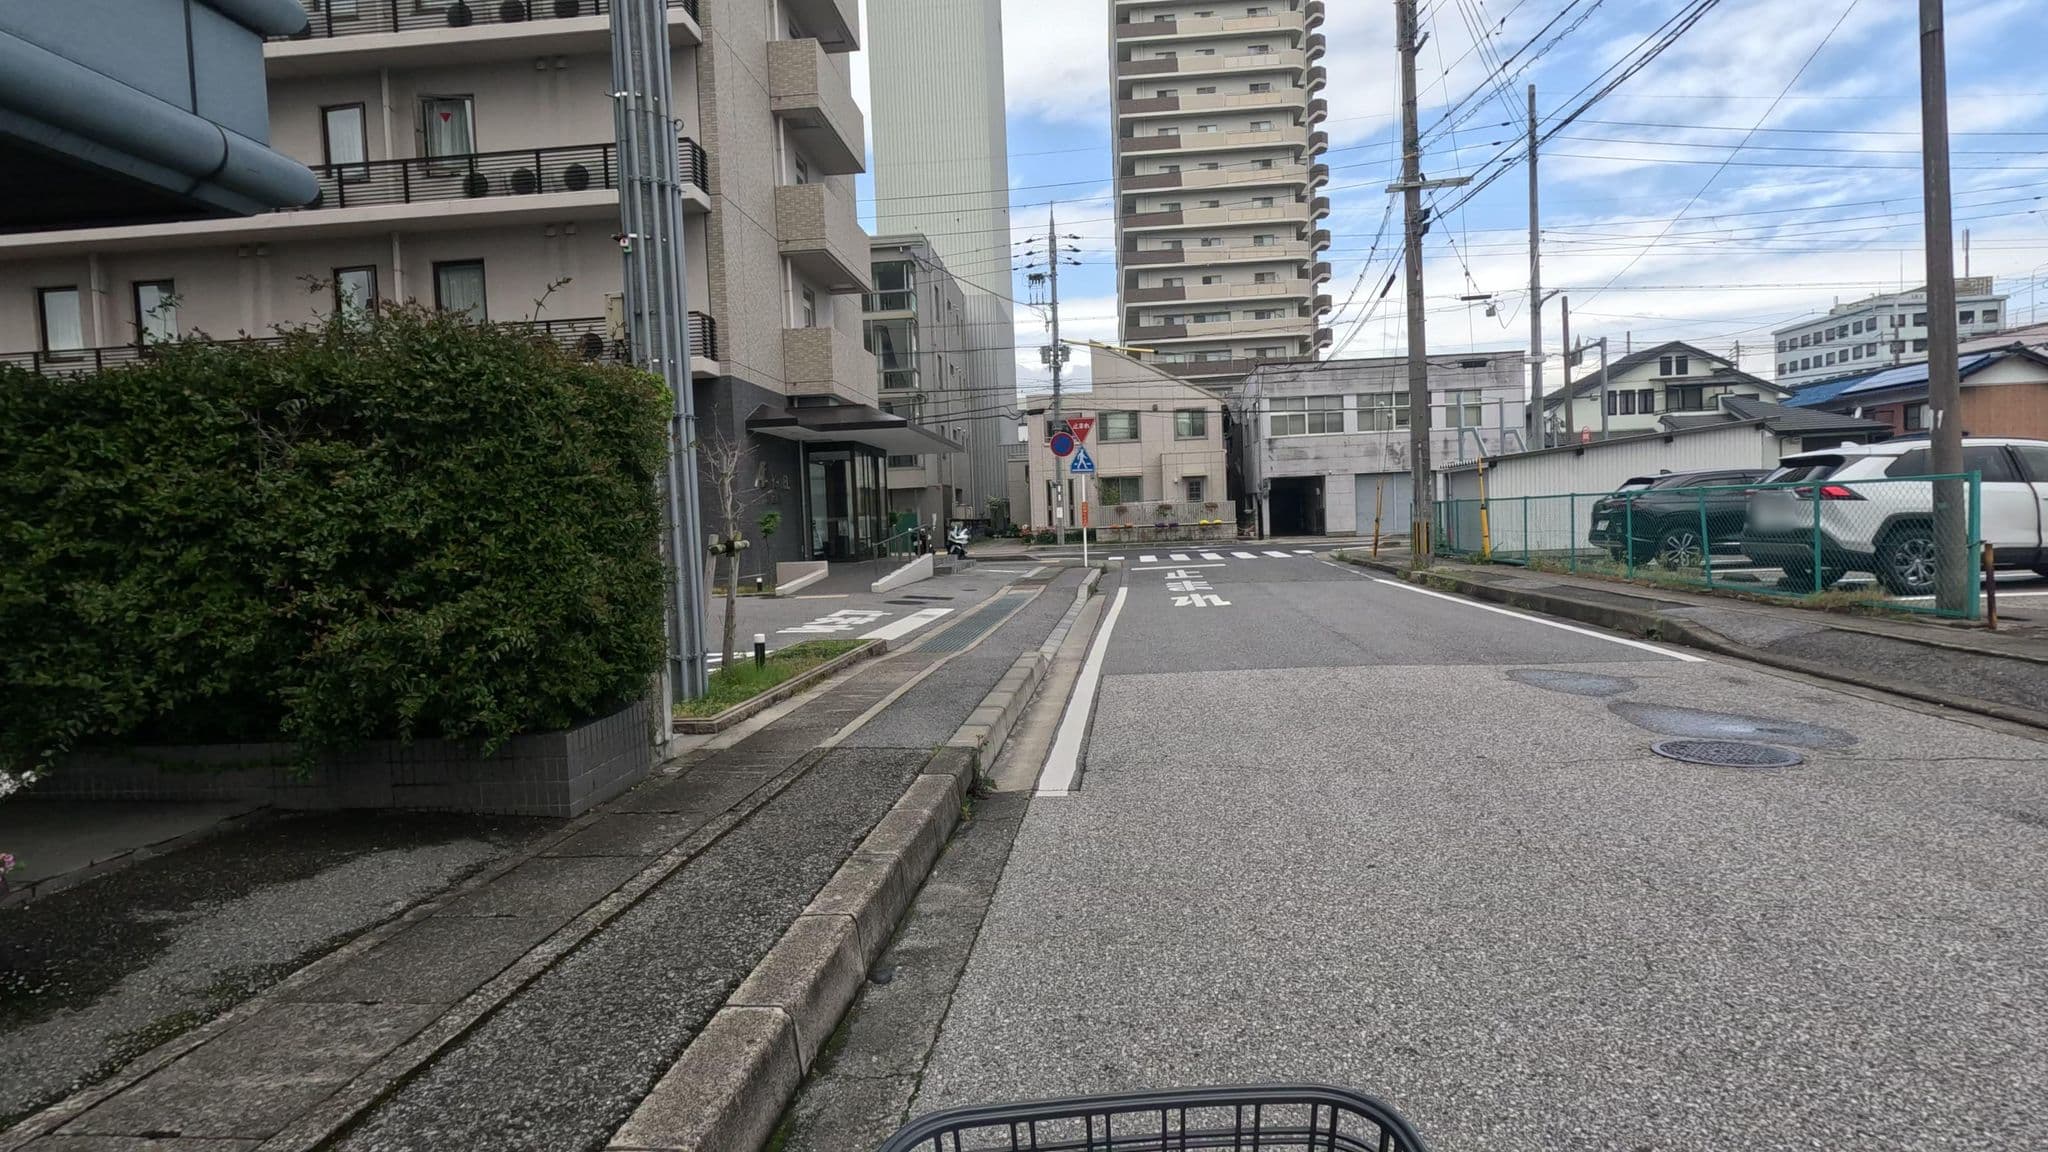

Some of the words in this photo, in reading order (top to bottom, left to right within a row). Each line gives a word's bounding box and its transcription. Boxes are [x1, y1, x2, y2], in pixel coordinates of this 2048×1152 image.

[1073, 422, 1090, 430] 止まれ
[1164, 569, 1231, 607] 止まれ
